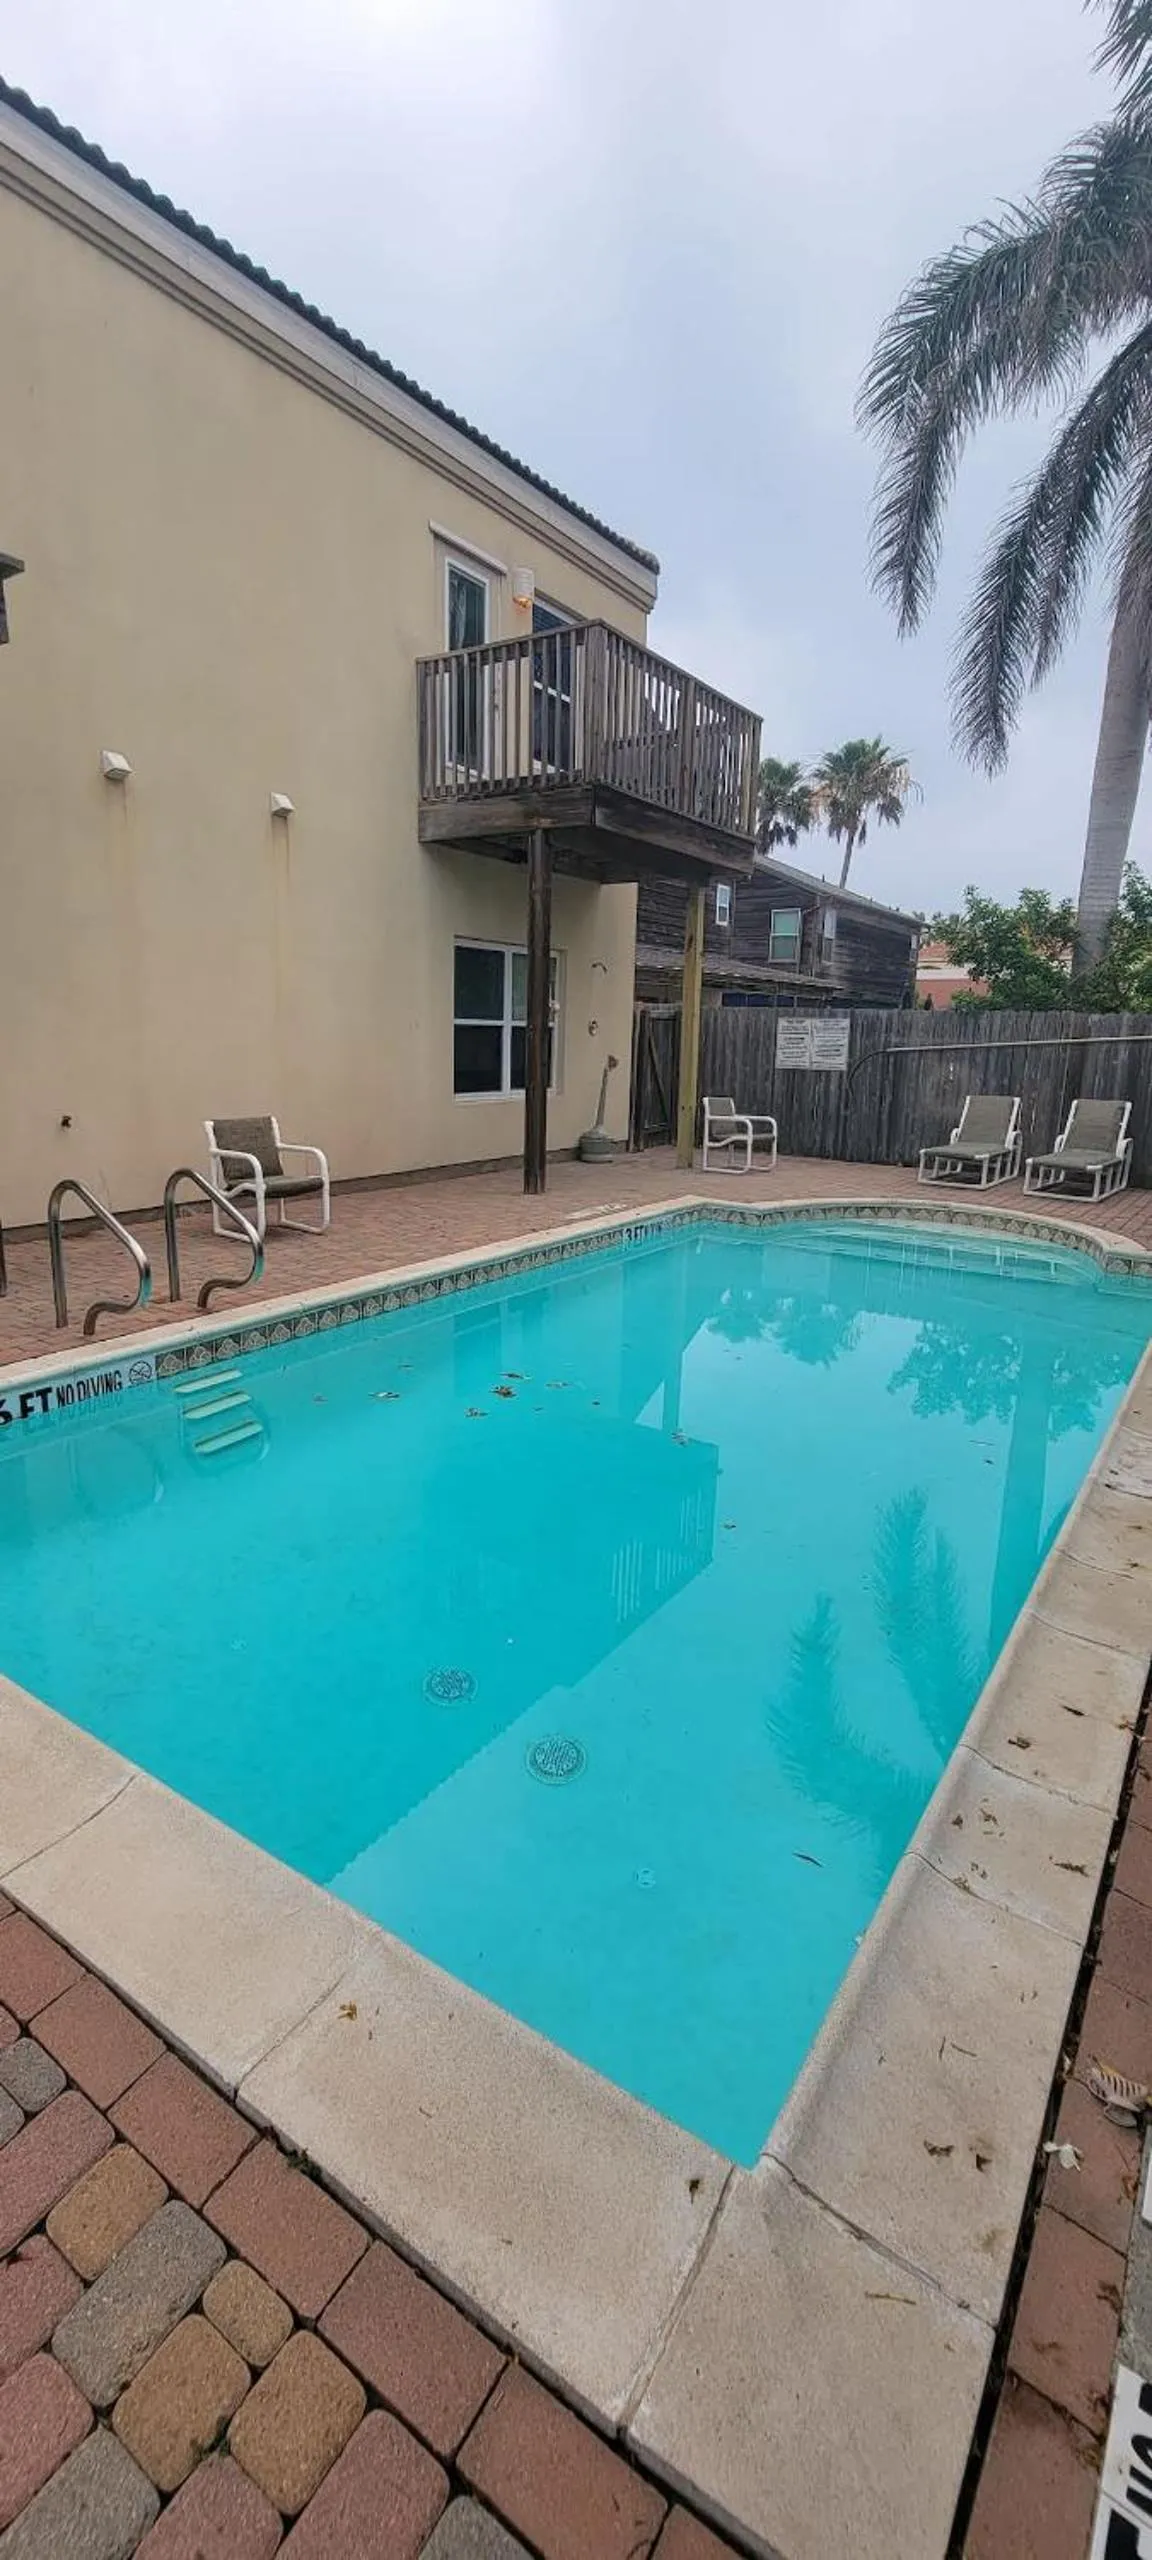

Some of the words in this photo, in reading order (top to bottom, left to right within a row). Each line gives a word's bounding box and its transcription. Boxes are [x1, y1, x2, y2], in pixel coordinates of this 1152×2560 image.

[19, 1387, 52, 1419] FT
[56, 1384, 75, 1408] NO
[76, 1370, 122, 1401] DIVING
